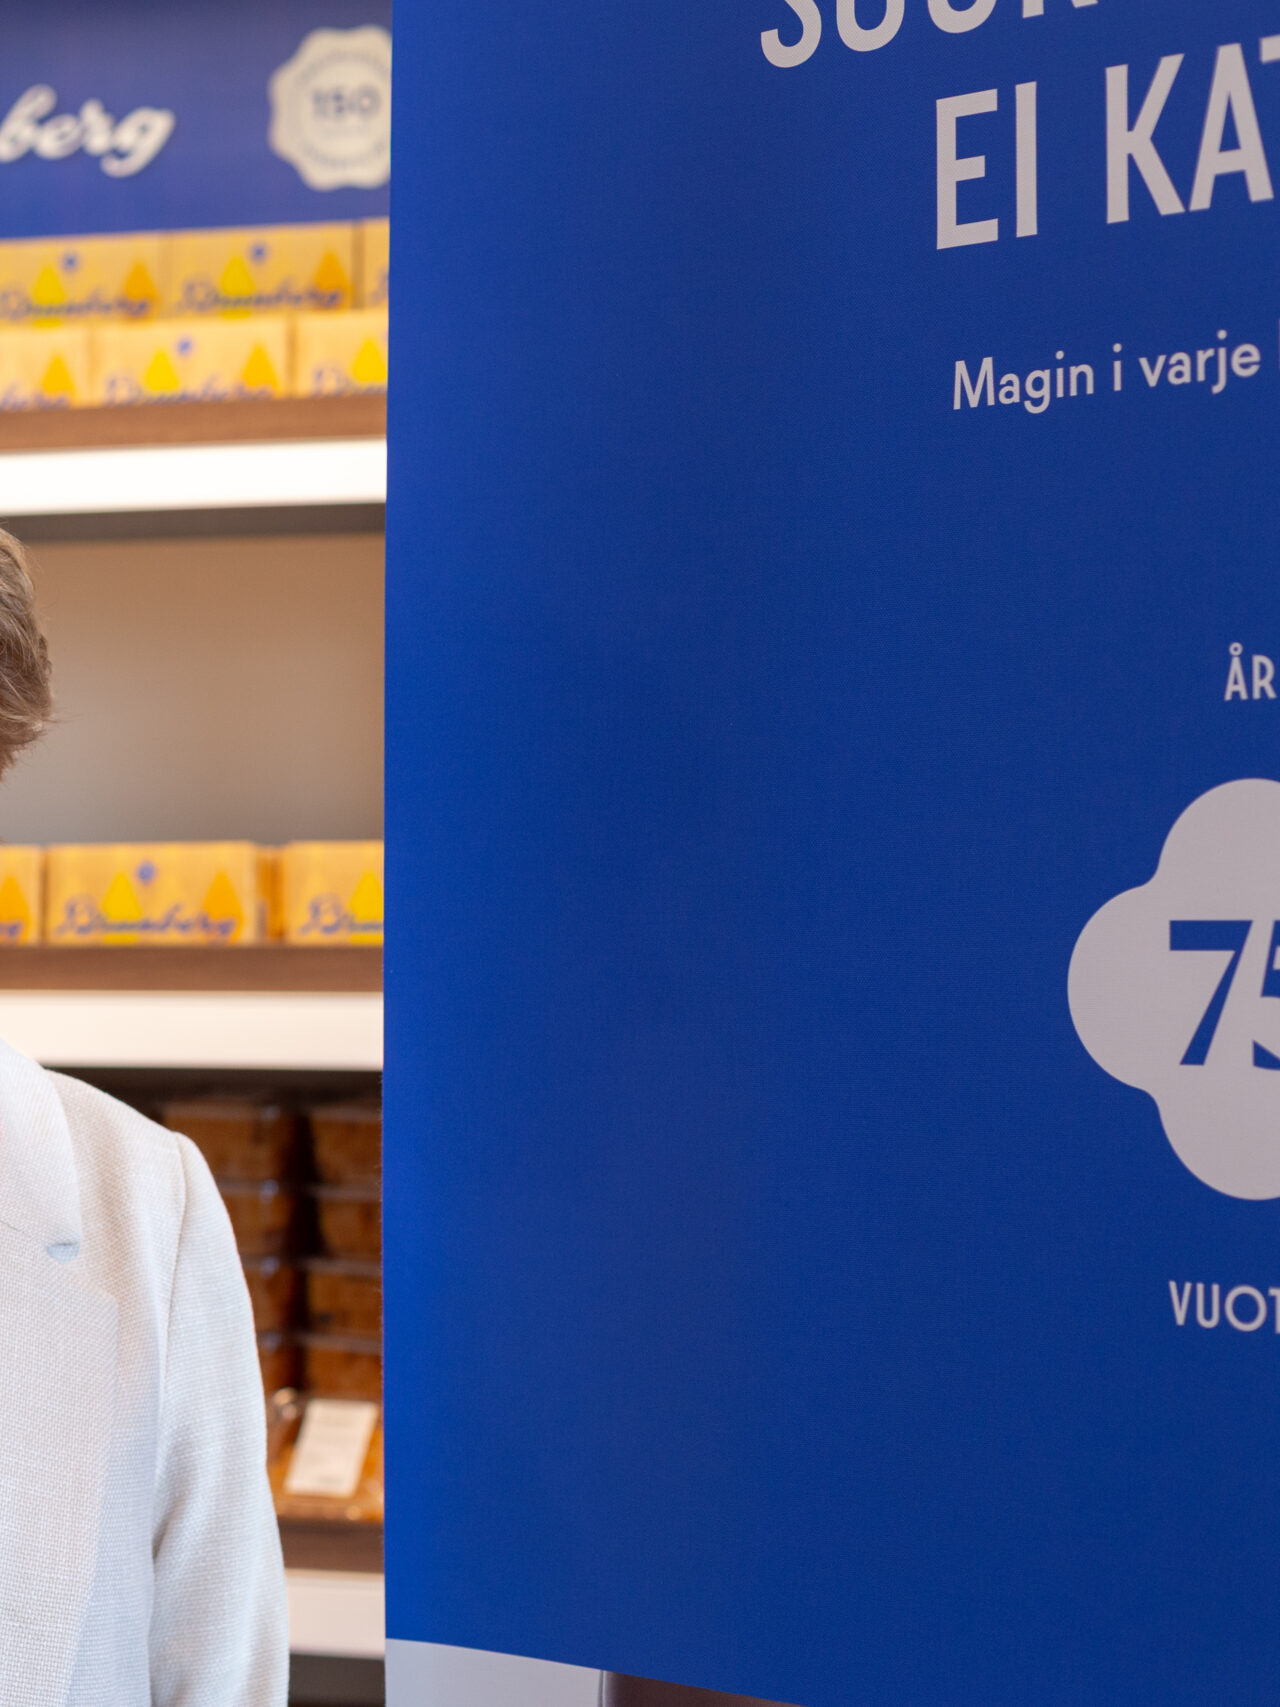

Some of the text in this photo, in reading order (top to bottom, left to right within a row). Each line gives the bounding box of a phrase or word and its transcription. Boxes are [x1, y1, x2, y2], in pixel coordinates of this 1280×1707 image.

[935, 34, 1280, 250] EI KA
[953, 350, 1094, 414] Magin
[1112, 342, 1123, 392] i
[1138, 329, 1261, 395] varje
[1224, 642, 1277, 701] ÅR
